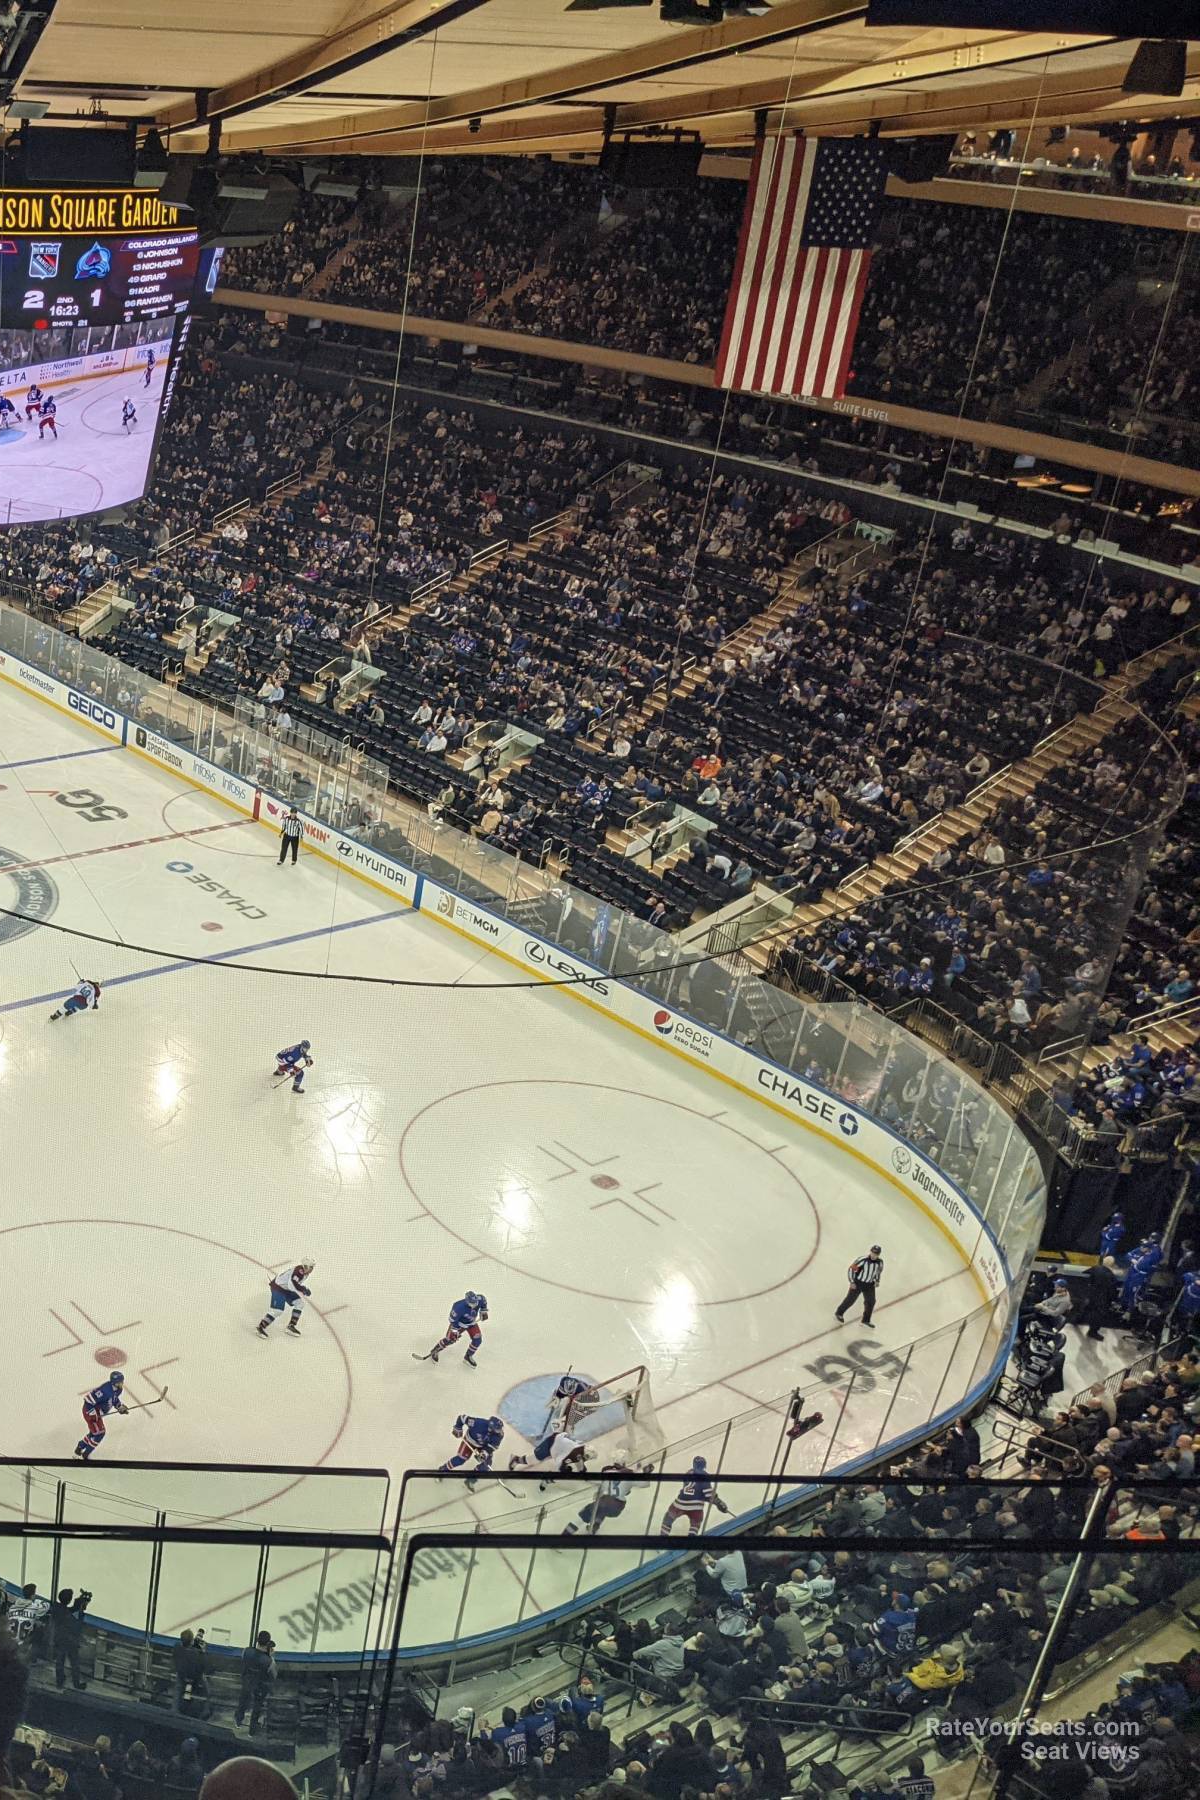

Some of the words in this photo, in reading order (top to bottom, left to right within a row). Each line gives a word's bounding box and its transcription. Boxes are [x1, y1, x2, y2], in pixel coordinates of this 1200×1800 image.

[49, 194, 117, 230] SQUARE
[121, 194, 178, 227] GARDEN
[128, 239, 166, 249] COLORADO
[144, 248, 178, 259] JOHNSON
[22, 290, 45, 309] 2
[49, 305, 80, 316] 16:23
[90, 289, 102, 307] 1
[833, 401, 860, 415] SUITE
[861, 406, 889, 421] LEVEL
[19, 667, 55, 694] ticketmaster
[67, 691, 116, 730] GEICO
[356, 850, 407, 888] HYUNDAI
[184, 872, 268, 921] CHASE
[546, 954, 610, 997] LEXUS
[674, 1021, 714, 1050] pepsi
[689, 1043, 710, 1058] SUGAR
[757, 1068, 836, 1124] CHASE
